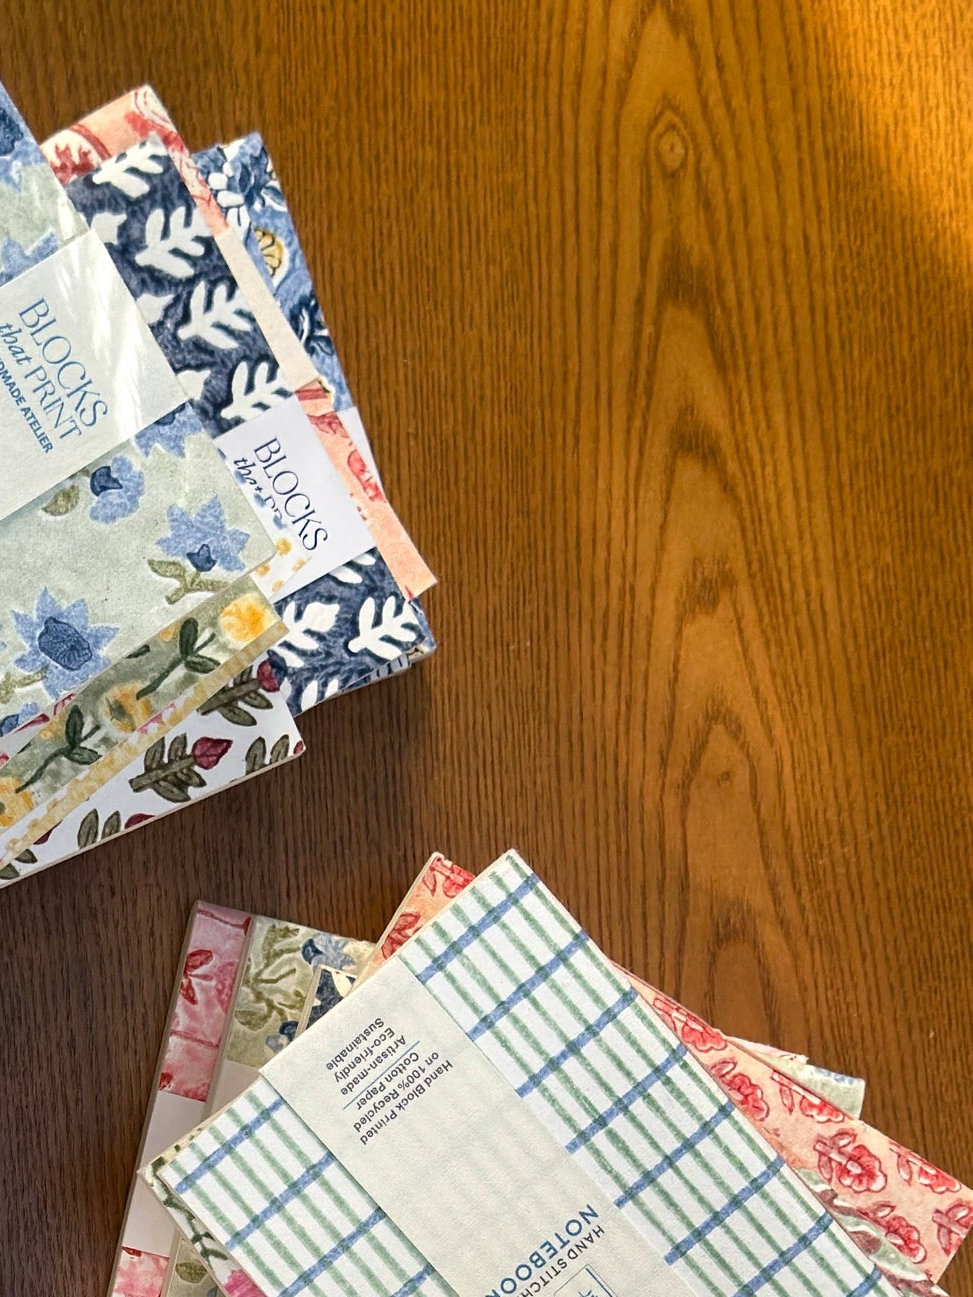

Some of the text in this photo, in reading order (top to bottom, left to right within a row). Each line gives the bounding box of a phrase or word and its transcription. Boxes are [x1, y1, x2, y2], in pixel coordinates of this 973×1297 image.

[18, 297, 108, 427] BLOCKS
[21, 406, 53, 453] ATELIER
[24, 365, 82, 439] PRINT
[254, 437, 328, 551] BLOCKS
[326, 1018, 384, 1071] Sustainable
[334, 1027, 395, 1083] Eco-friendly
[340, 1035, 406, 1096] Artisan-made
[353, 1052, 439, 1133] on 100% Recycled
[356, 1052, 419, 1110] Cotton Paper
[360, 1060, 453, 1145] Hand Block Printed
[567, 1225, 605, 1260] HAND
